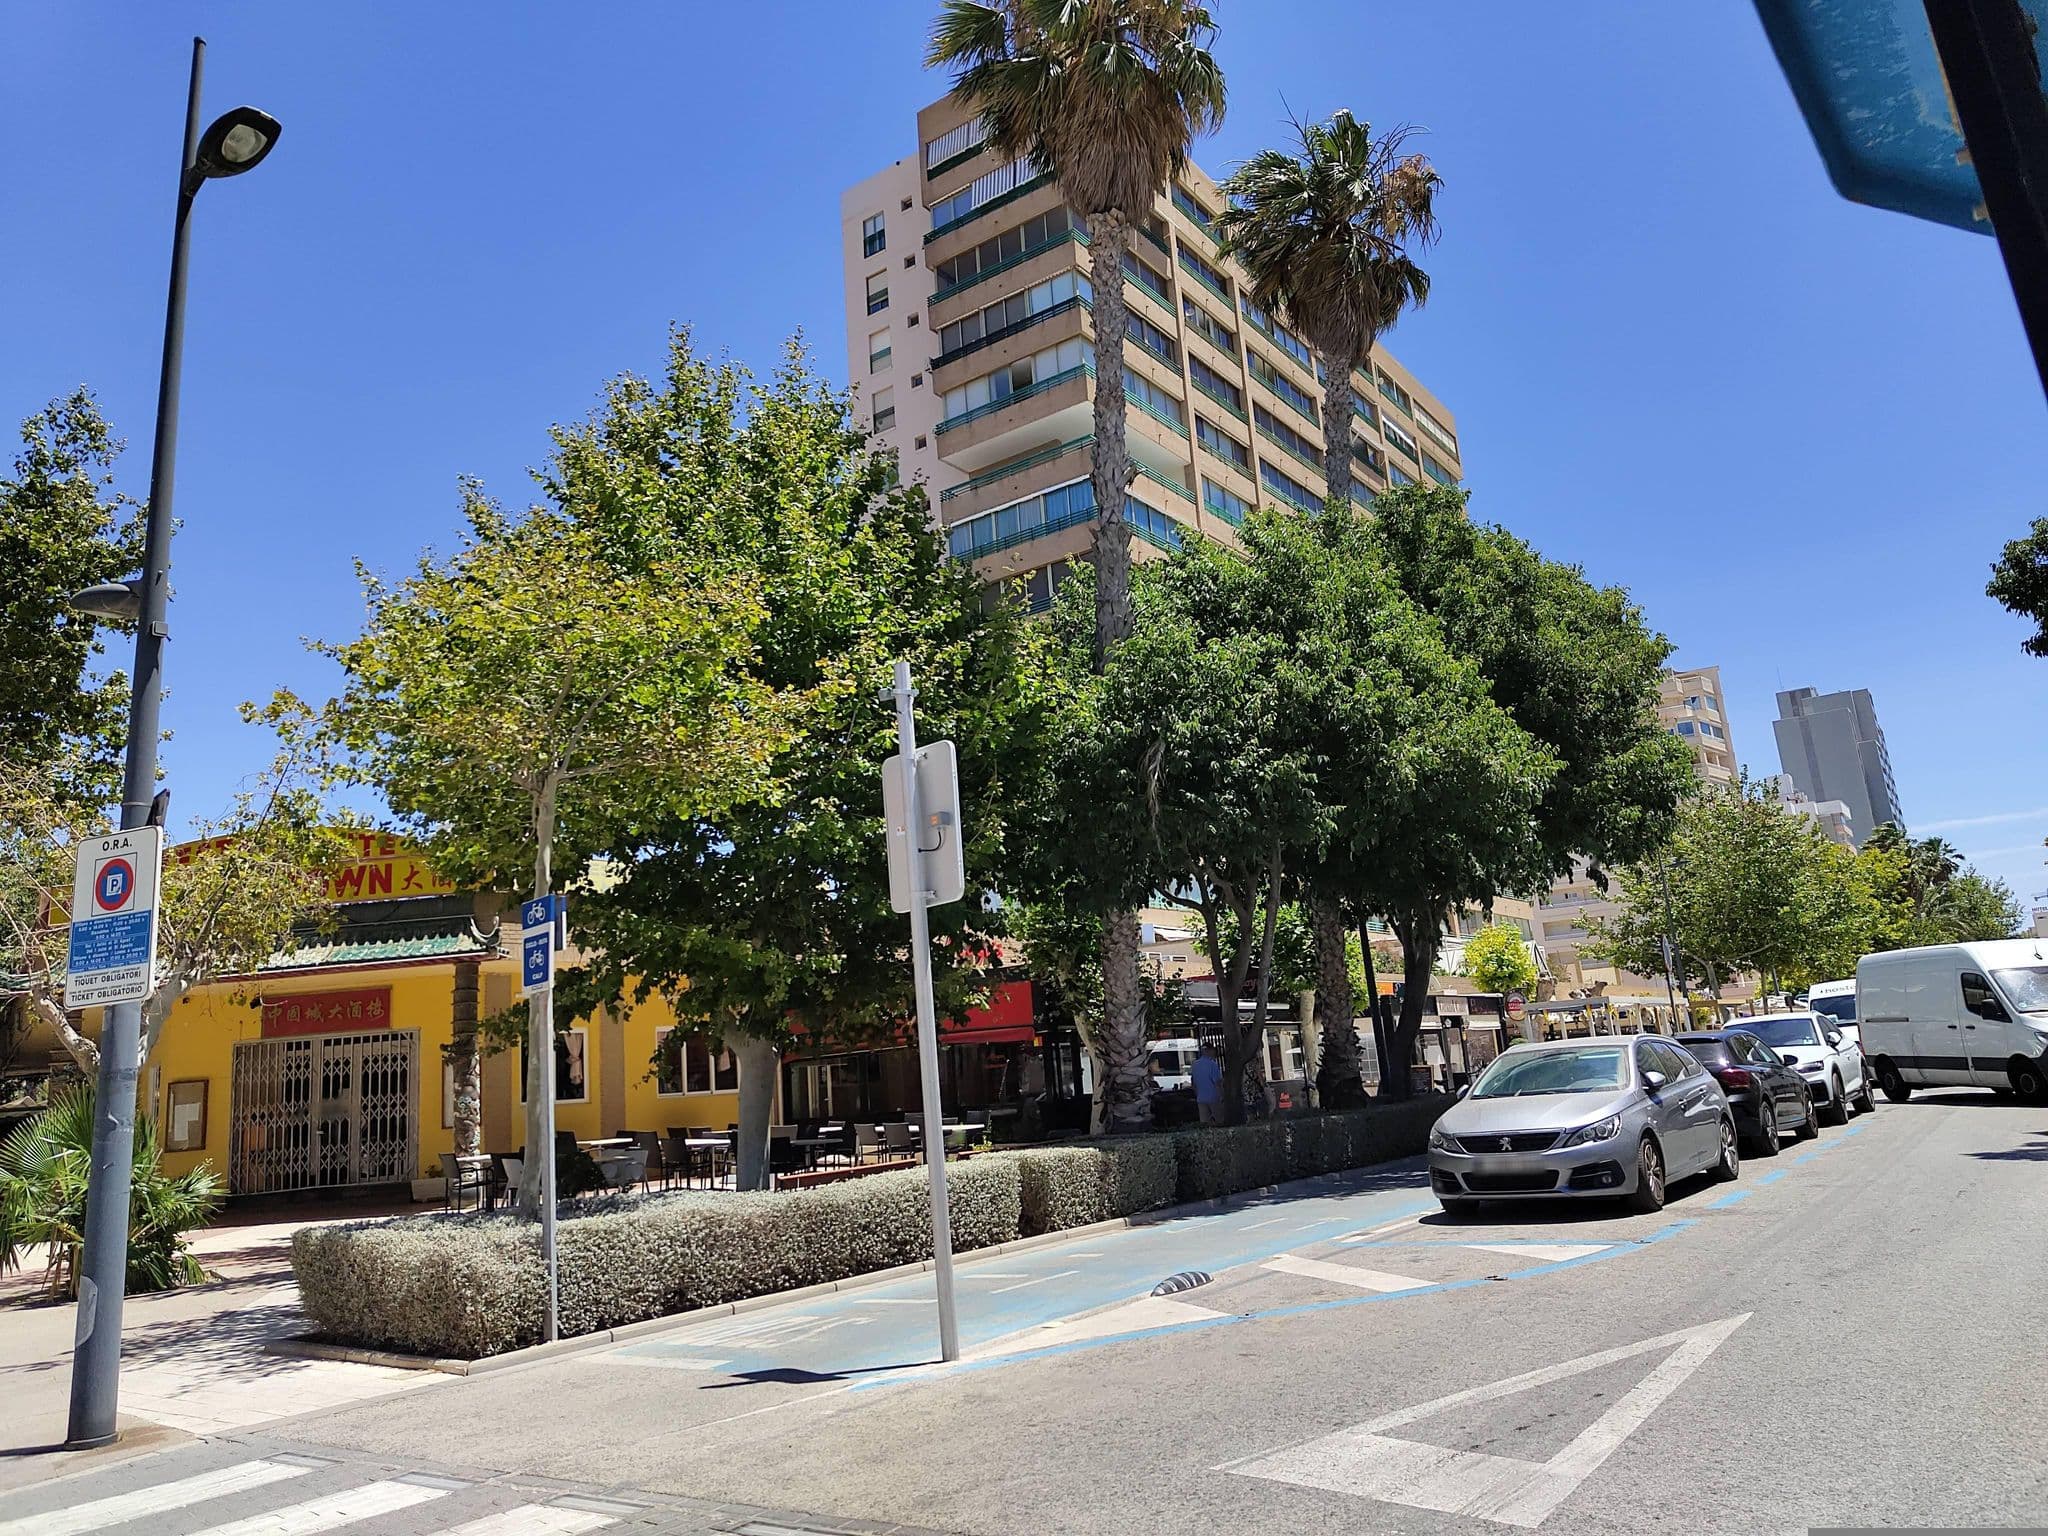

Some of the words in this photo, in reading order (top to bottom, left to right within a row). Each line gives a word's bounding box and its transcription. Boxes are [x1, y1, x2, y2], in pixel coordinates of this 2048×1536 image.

[102, 837, 132, 851] O.R.A.
[75, 976, 98, 987] TIQUET
[101, 970, 142, 983] OBLIGATORI
[71, 992, 94, 1002] TICKET
[97, 985, 143, 998] OBLIGATORIO
